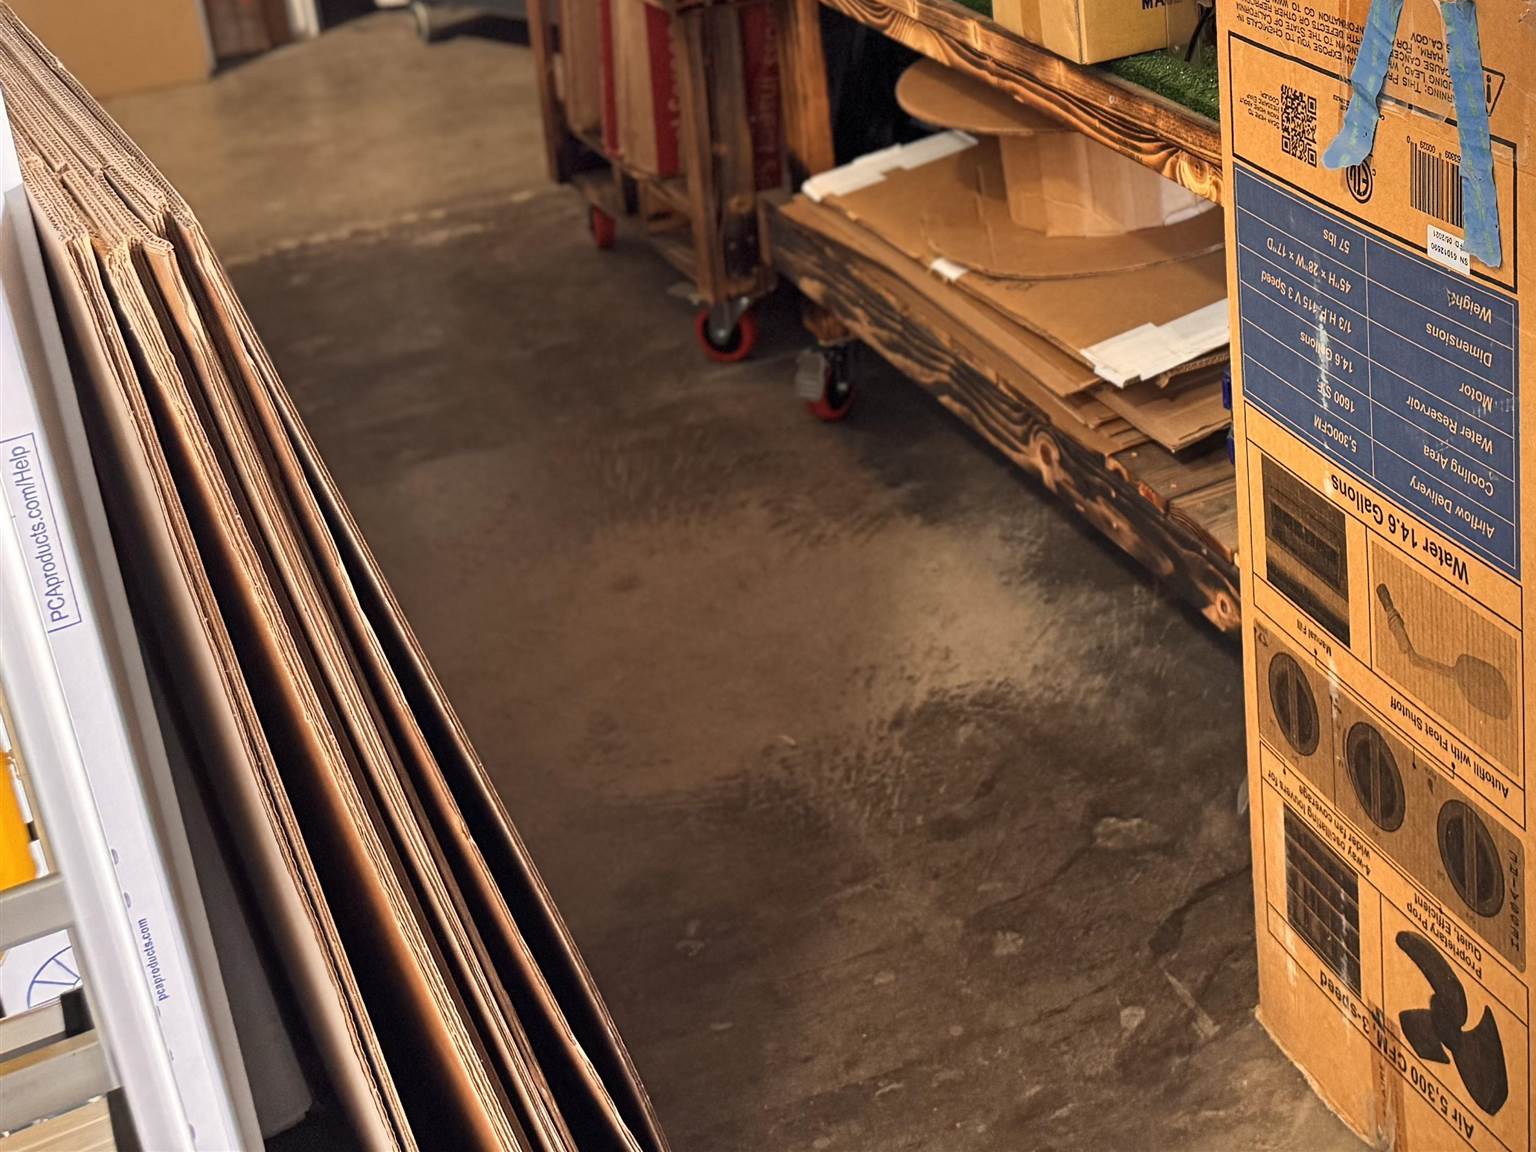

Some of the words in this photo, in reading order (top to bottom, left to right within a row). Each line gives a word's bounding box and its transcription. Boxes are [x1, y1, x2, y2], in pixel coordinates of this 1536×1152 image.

[1322, 228, 1338, 248] lbs
[1338, 239, 1351, 254] 57
[1261, 270, 1288, 297] Speed
[1446, 288, 1493, 325] Weight
[1425, 323, 1493, 368] Dimensions
[1335, 352, 1354, 374] 14.6
[1334, 393, 1356, 414] 1600
[1459, 383, 1494, 412] Motor
[1406, 397, 1456, 433] Reservoir
[1423, 443, 1448, 469] Area
[1455, 427, 1494, 455] Water
[1450, 458, 1494, 497] Cooling
[1331, 474, 1384, 525] Gallons
[1409, 475, 1453, 515] Delivery
[9, 445, 70, 624] PCAproducts.com/Help
[1388, 515, 1419, 552] 14.6
[1455, 508, 1495, 538] Airflow
[1422, 540, 1470, 585] Water
[1390, 696, 1424, 735] Shutoff
[1424, 725, 1450, 752] Float
[1451, 749, 1473, 772] with
[1474, 767, 1509, 798] Autofill
[1334, 819, 1347, 840] fan
[1348, 833, 1371, 860] wider
[1406, 901, 1429, 930] Prop
[1414, 892, 1458, 937] Efficient
[136, 915, 172, 1001] pcaproducts.com
[1421, 916, 1483, 980] Proprietary
[1459, 933, 1483, 962] Quiet,
[1319, 969, 1371, 1031] 3-speed
[1411, 1069, 1449, 1116] 5,300
[1451, 1109, 1475, 1139] Air
